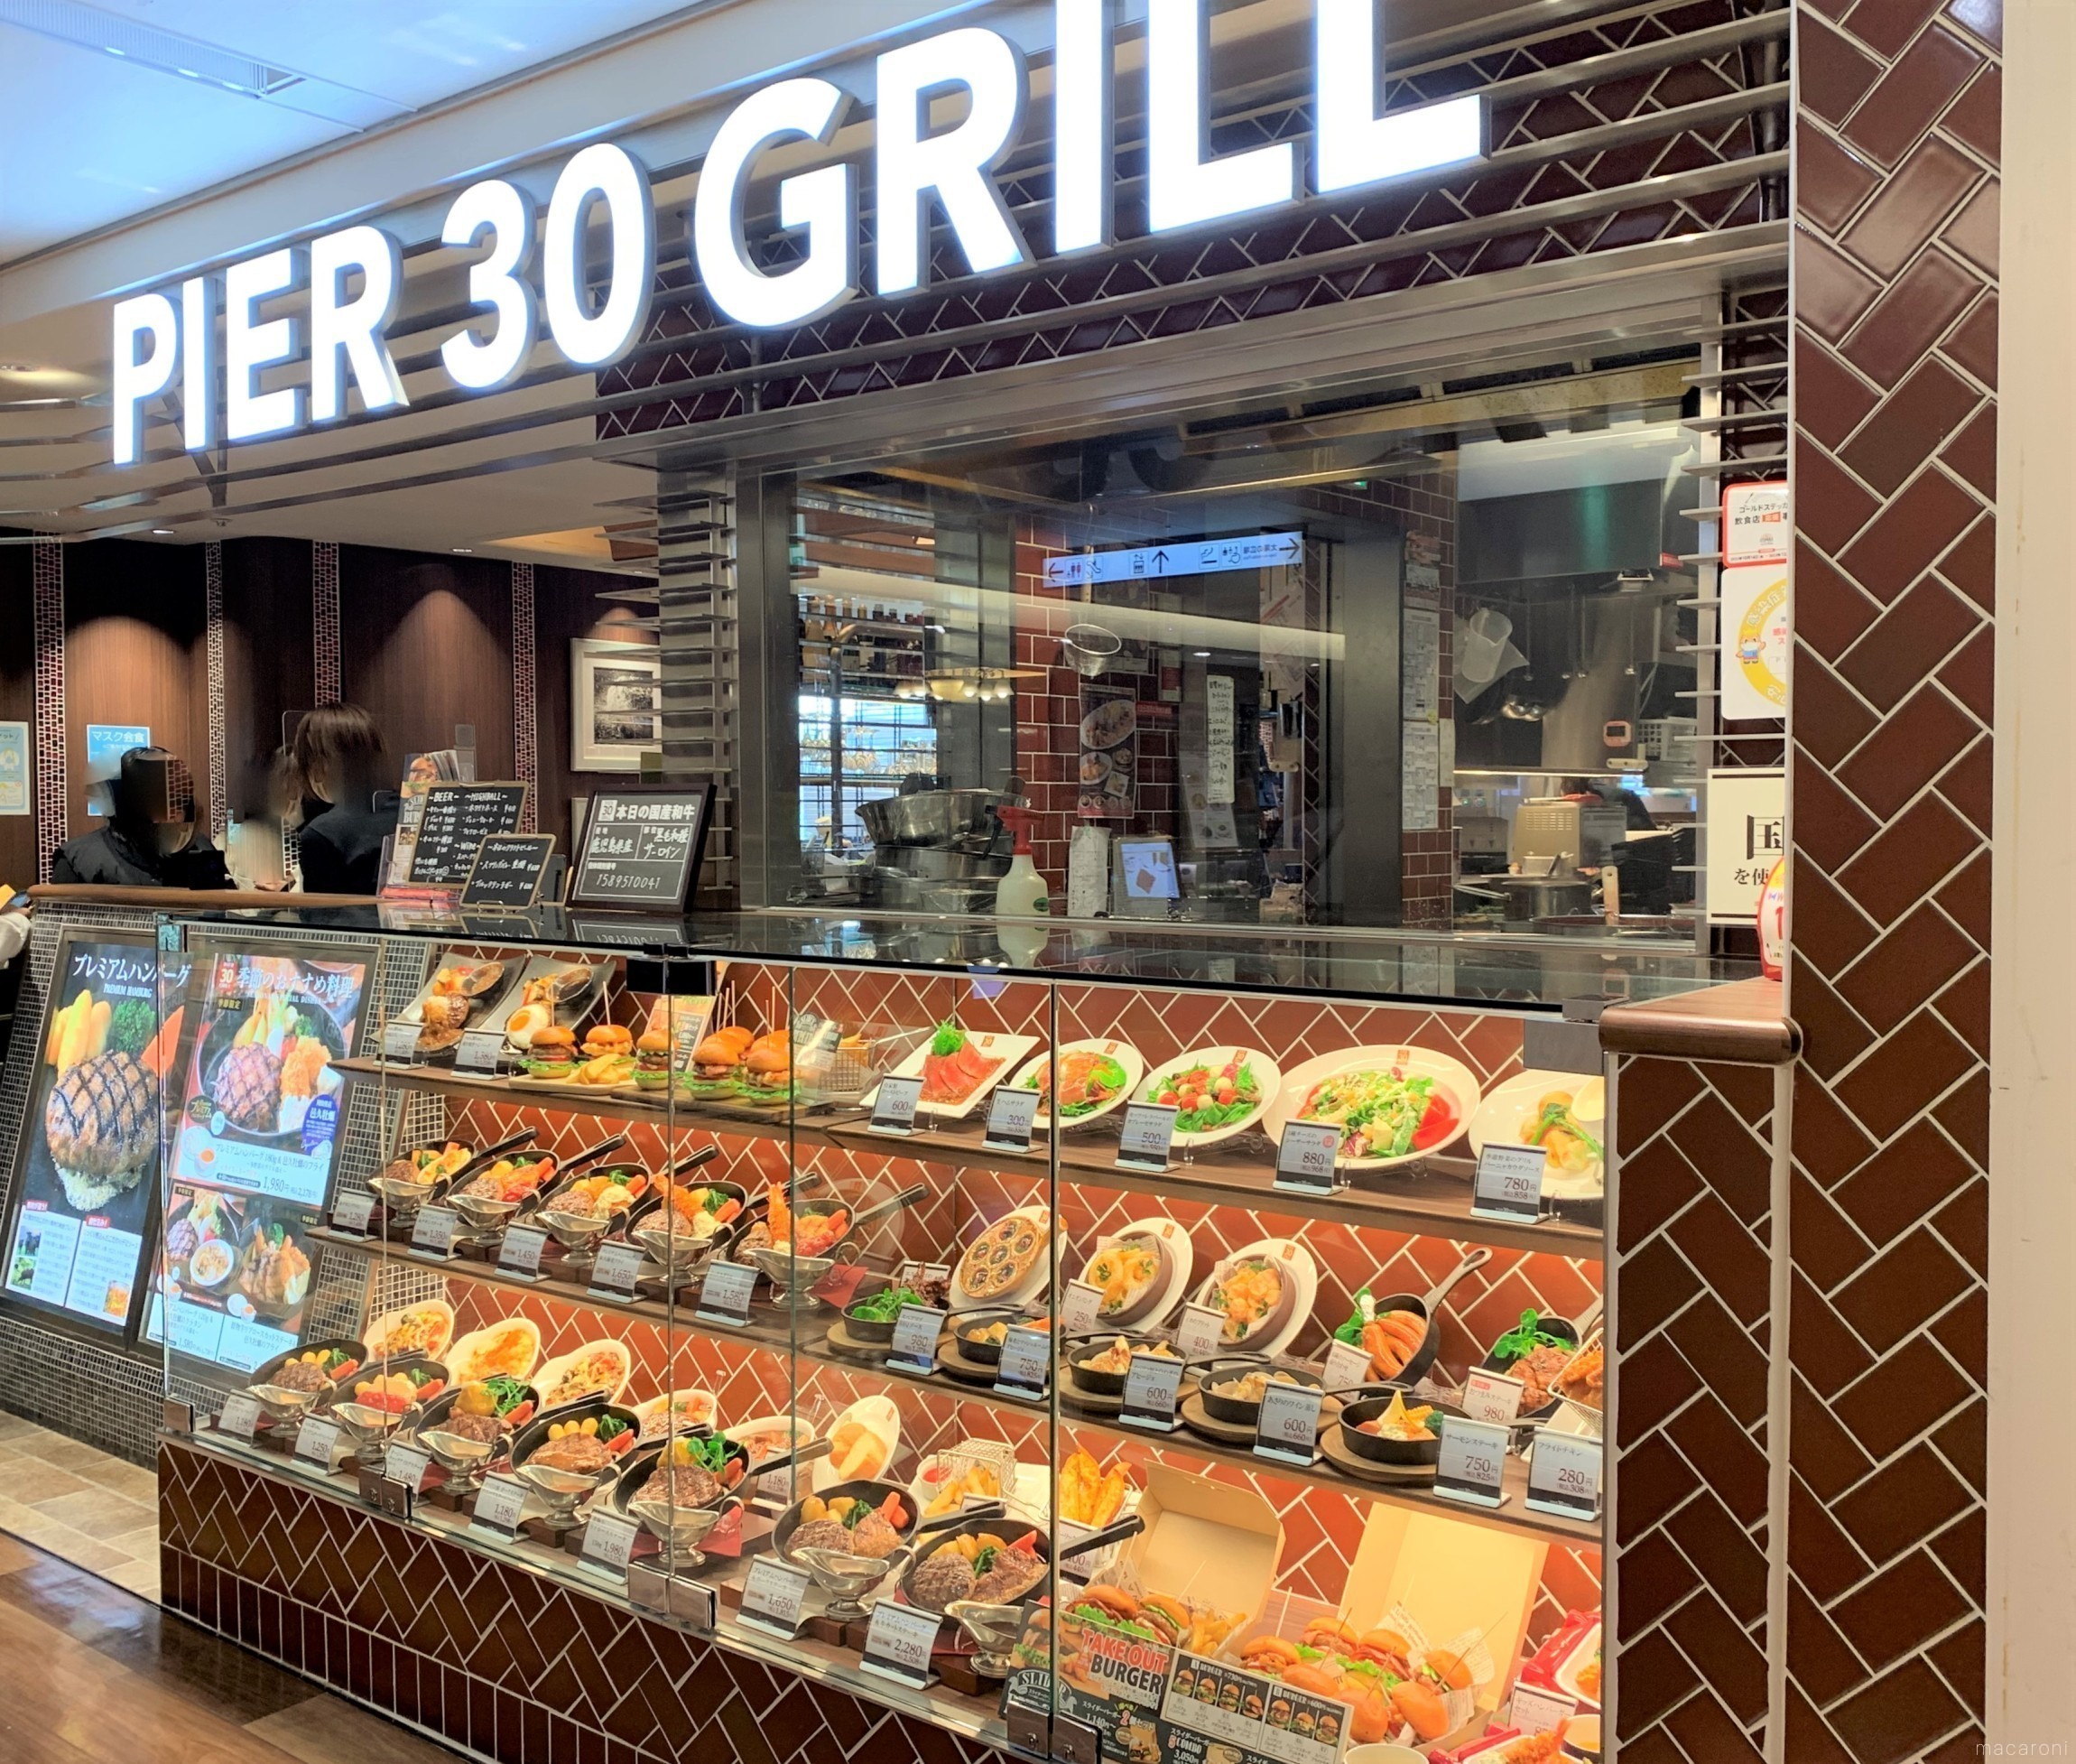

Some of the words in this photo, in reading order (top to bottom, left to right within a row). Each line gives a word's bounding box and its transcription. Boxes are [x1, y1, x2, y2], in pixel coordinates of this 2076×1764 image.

[112, 226, 410, 467] PIER
[440, 143, 655, 390] 30
[693, 0, 1491, 330] GRILL
[1734, 515, 1761, 525] 飲食店
[91, 731, 145, 744] マスク会食
[616, 803, 696, 821] 本日の国産和牛
[1746, 814, 1784, 860] 国
[596, 873, 662, 890] 1589510041
[219, 967, 235, 984] 30
[236, 966, 354, 998] 季節のおすすめ料理
[1302, 1151, 1331, 1165] 880円
[1504, 1176, 1537, 1192] 780円
[1146, 1387, 1173, 1400] 600円
[1284, 1417, 1313, 1434] 600円
[1445, 1433, 1499, 1450] サーモンステーキ
[1464, 1454, 1498, 1473] 750円
[1557, 1467, 1593, 1487] 280円
[894, 1639, 927, 1660] 2,280円
[1082, 1629, 1126, 1661] TAKE
[1128, 1644, 1169, 1675] OUT
[1089, 1653, 1163, 1695] BURGER
